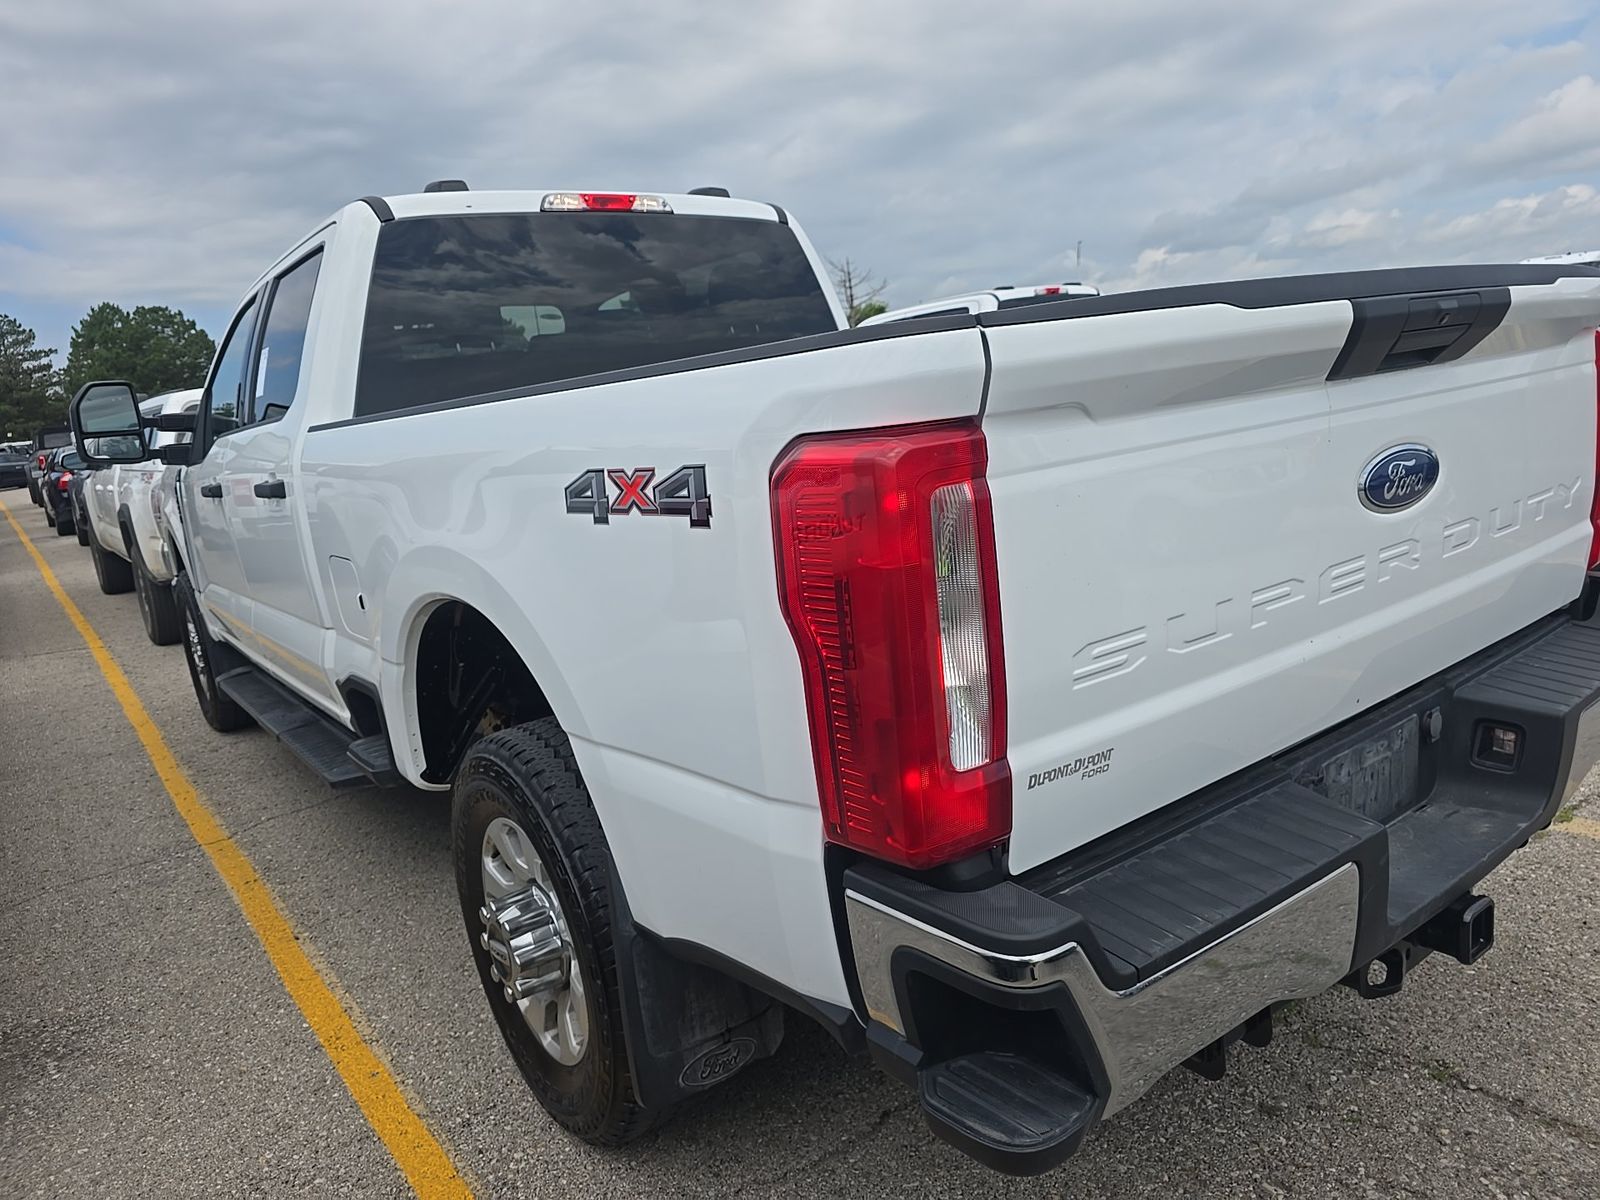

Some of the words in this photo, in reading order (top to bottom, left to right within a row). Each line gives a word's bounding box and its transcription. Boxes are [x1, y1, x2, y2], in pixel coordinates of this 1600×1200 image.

[1384, 458, 1423, 500] Ford
[1072, 537, 1420, 690] SUPER
[1441, 476, 1582, 558] DUTY
[1081, 764, 1109, 780] FORD
[699, 1046, 741, 1080] Ford
